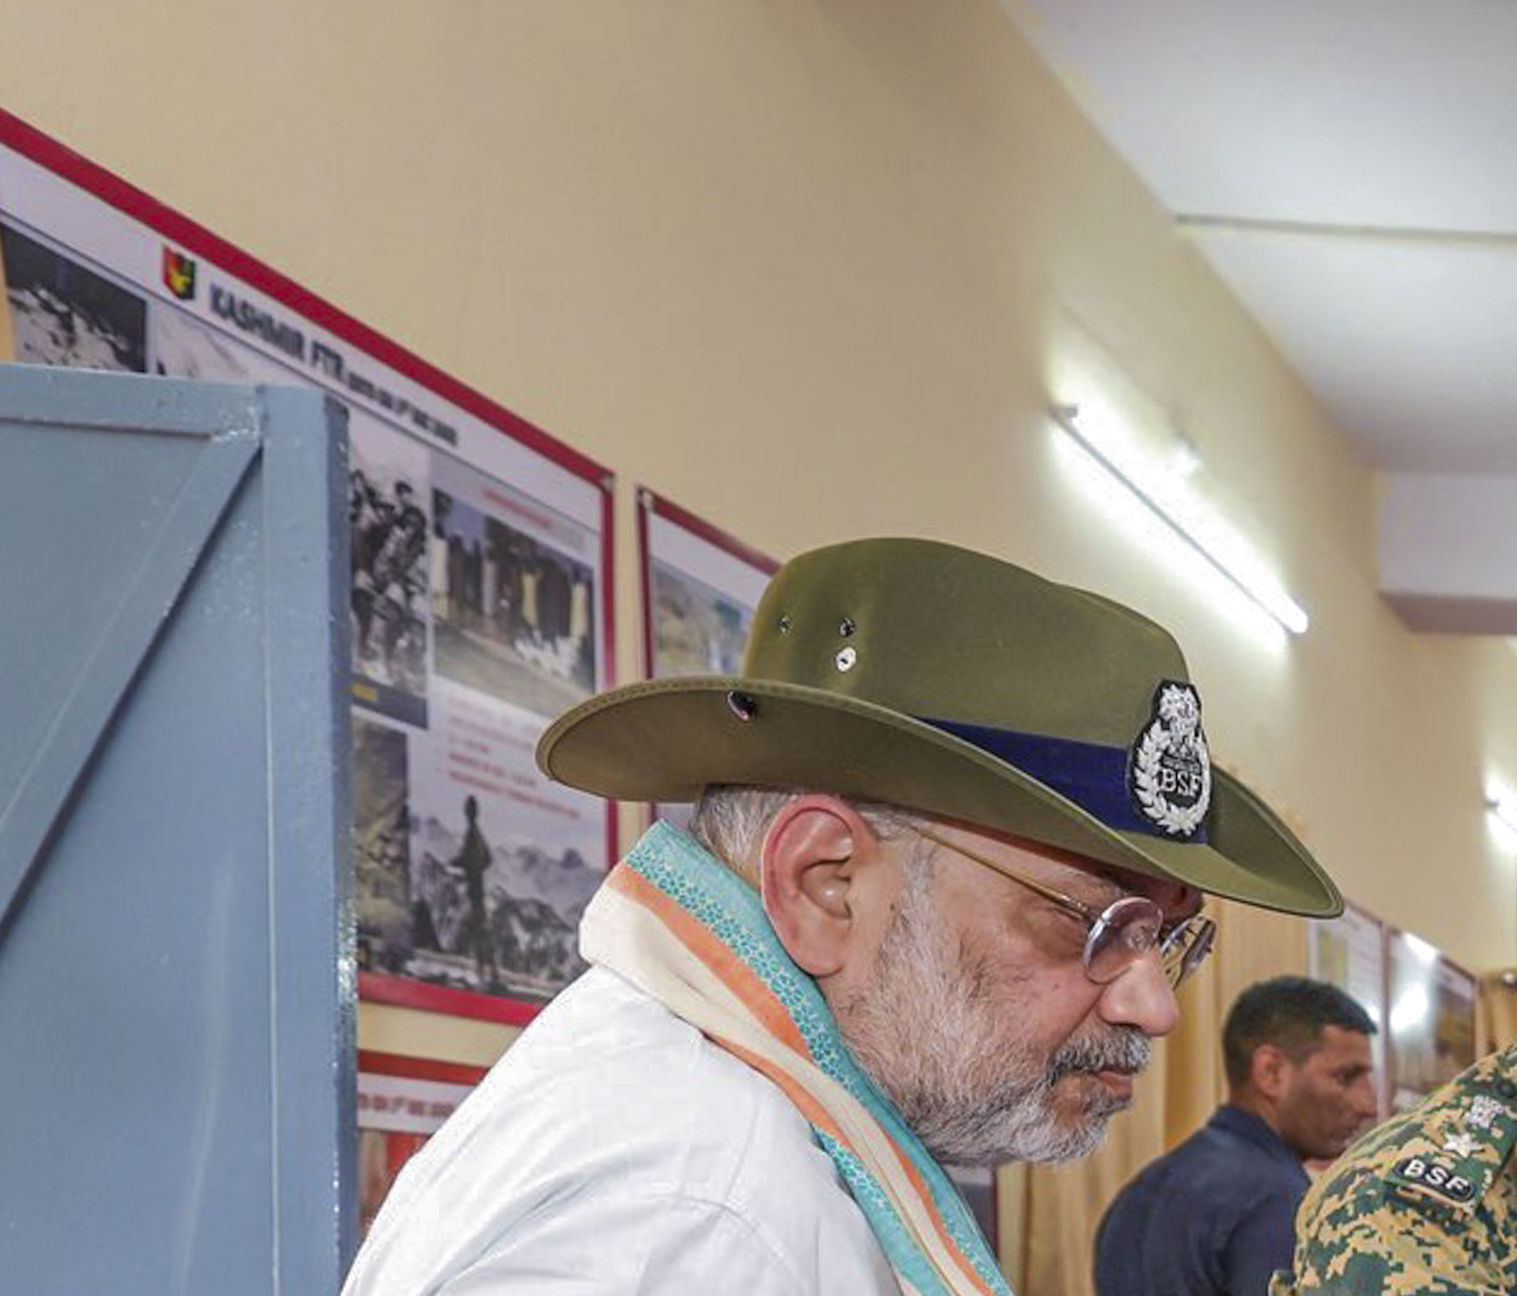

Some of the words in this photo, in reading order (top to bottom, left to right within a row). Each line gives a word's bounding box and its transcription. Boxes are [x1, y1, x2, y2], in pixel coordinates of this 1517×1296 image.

[208, 282, 305, 362] KASHMIR
[1161, 767, 1201, 797] BSF
[1404, 1159, 1469, 1190] BSF
